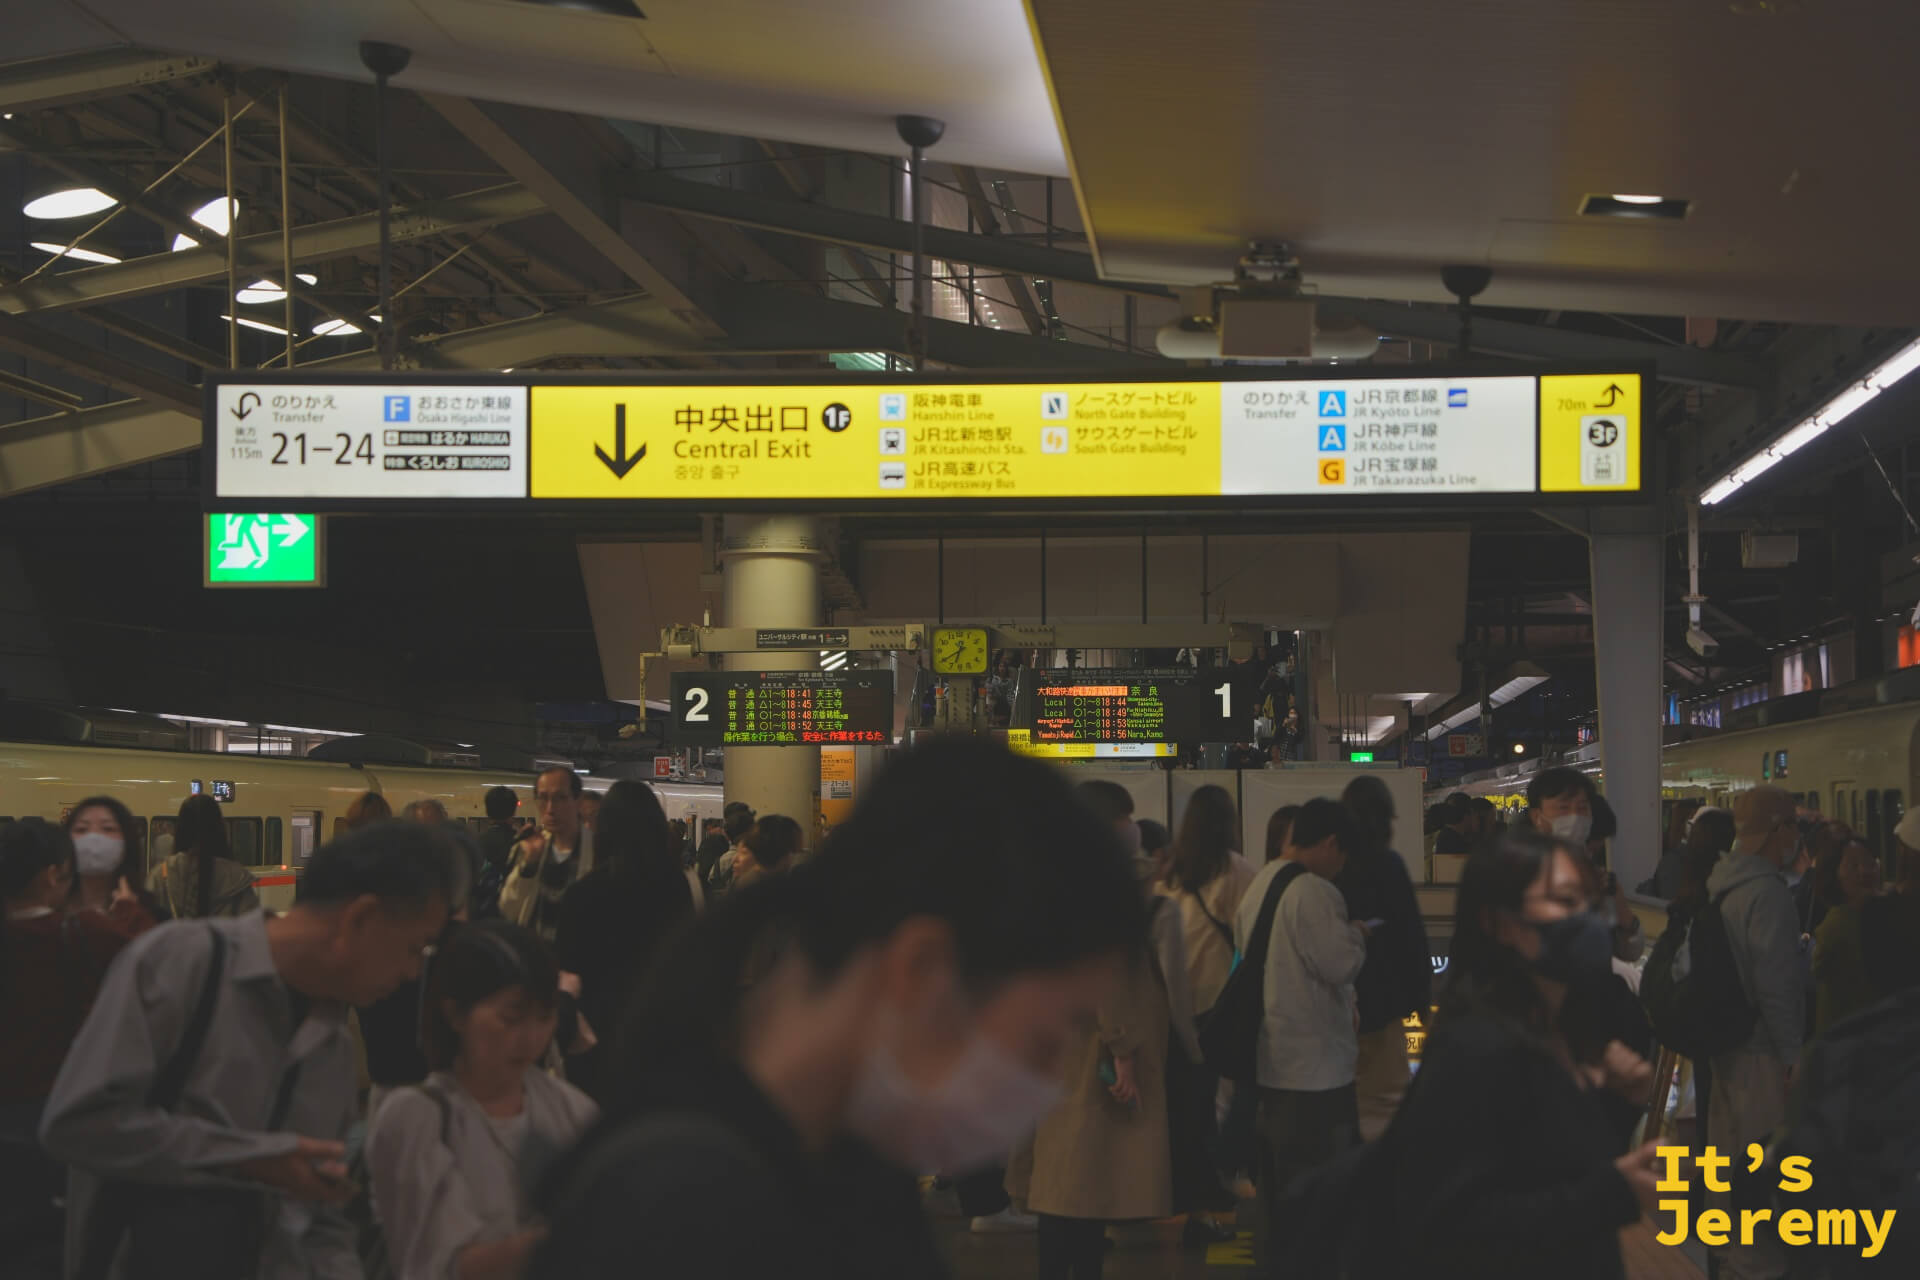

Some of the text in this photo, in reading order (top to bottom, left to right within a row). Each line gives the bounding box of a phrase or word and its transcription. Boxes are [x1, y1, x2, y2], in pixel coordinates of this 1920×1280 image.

[272, 395, 336, 409] のりかえ
[418, 396, 511, 409] おおさか東線
[913, 393, 982, 408] 阪神電車
[1075, 392, 1197, 406] ノースゲートビル
[1244, 391, 1310, 406] のりかえ
[1354, 389, 1438, 405] JR京都線
[1558, 399, 1587, 411] 70m
[272, 412, 324, 423] Transfer
[490, 413, 511, 424] Line
[674, 404, 808, 433] 中央出口
[825, 407, 850, 428] 1F
[913, 411, 995, 421] Hanshin Line
[1075, 408, 1186, 421] North Gate Building
[1244, 409, 1296, 419] Transfer
[1354, 408, 1367, 418] JR
[1415, 407, 1441, 417] Line
[913, 427, 1012, 442] JR北新地駅
[1076, 426, 1198, 440] サウスゲートビル
[1354, 423, 1438, 439] JR神戸線
[1591, 423, 1617, 444] 3F
[431, 431, 469, 445] はるか
[272, 433, 375, 464] 21-24
[674, 439, 811, 459] Central Exit
[913, 445, 1027, 455] JR Kitashinchi Sta.
[1075, 443, 1186, 456] South Gate Building
[1354, 442, 1367, 452] JR
[1409, 441, 1436, 451] Line
[231, 448, 263, 459] 115m
[408, 456, 460, 469] くろしお
[913, 461, 1011, 476] JR高速バス
[1354, 457, 1438, 473] JR宝塚線
[914, 478, 1016, 491] JR Expressway Bus
[1354, 475, 1476, 486] JR Takarazuka Line
[787, 689, 811, 699] 18:41
[816, 689, 843, 699] 天王寺
[1214, 683, 1230, 717] 1
[685, 688, 710, 722] 2
[787, 700, 811, 710] 18:45
[816, 700, 843, 710] 天王寺
[1044, 698, 1066, 706] Local
[1101, 698, 1127, 706] 18:44
[787, 711, 811, 721] 18:48
[1044, 708, 1066, 717] Local
[1101, 708, 1127, 717] 18:49
[787, 721, 811, 731] 18:52
[816, 721, 843, 731] 天王寺
[1101, 719, 1127, 727] 18:53
[1101, 730, 1127, 738] 18:56
